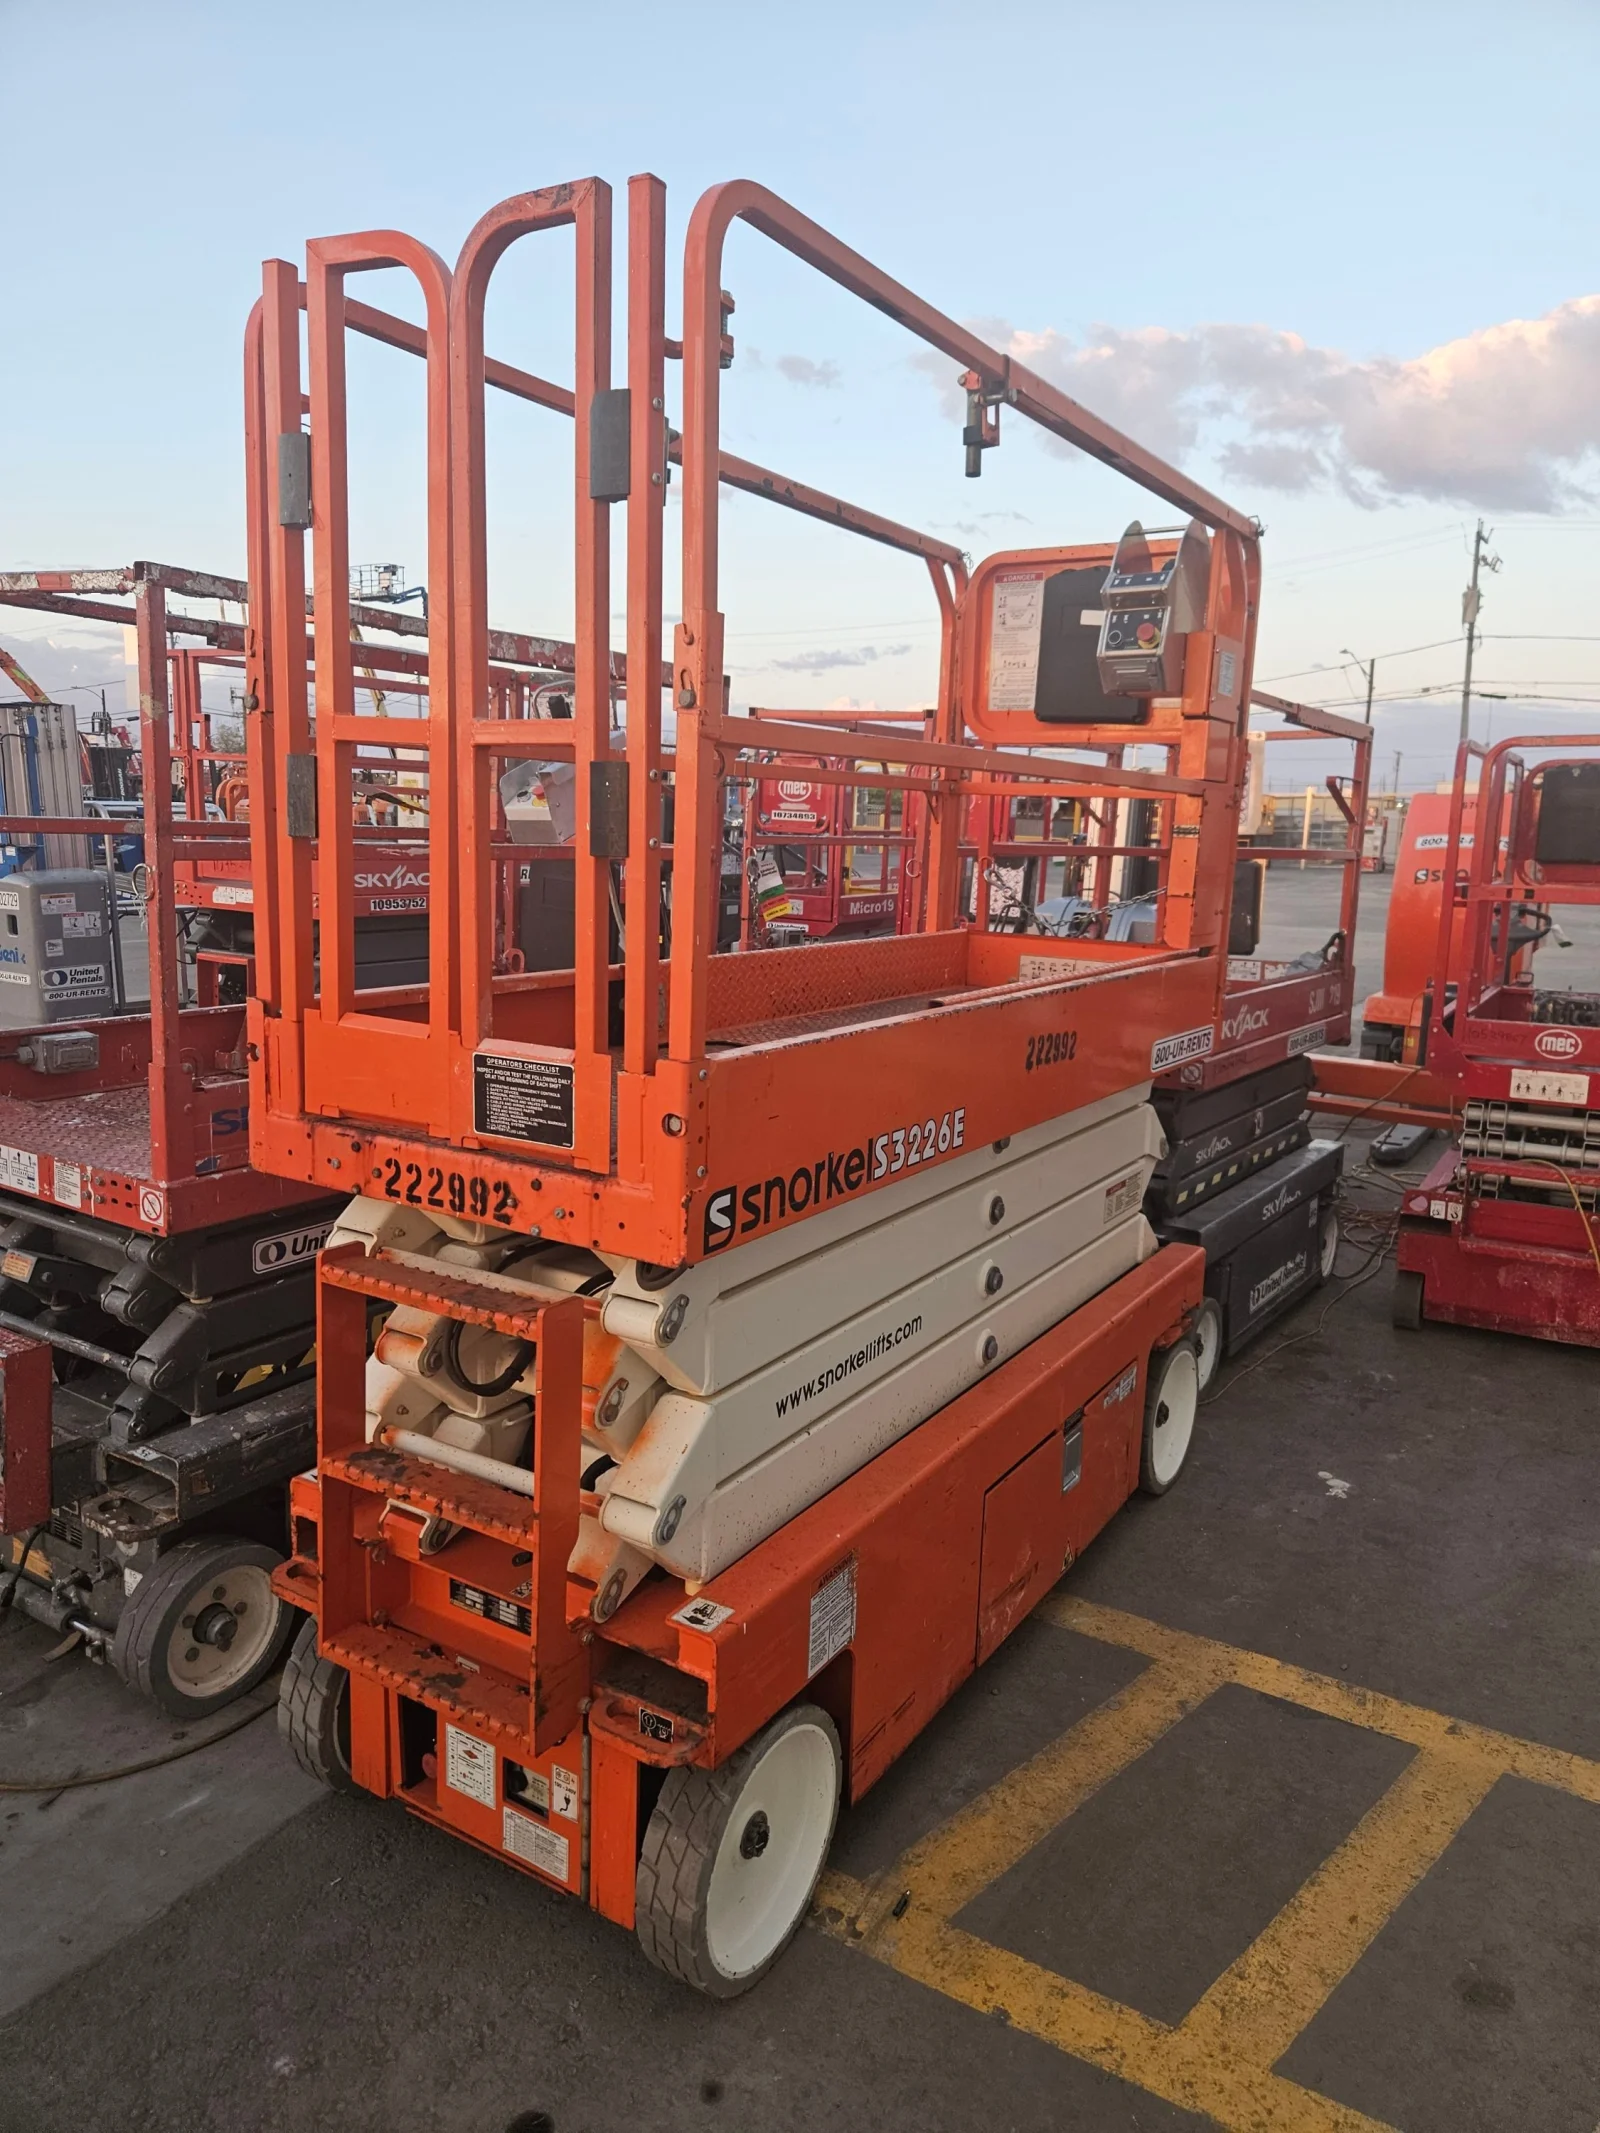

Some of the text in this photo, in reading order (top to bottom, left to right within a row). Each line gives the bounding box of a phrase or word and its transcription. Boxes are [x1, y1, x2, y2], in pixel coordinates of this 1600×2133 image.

[772, 811, 816, 821] 10734893
[353, 865, 430, 889] SKYJAC
[371, 897, 426, 911] 10953752
[850, 899, 895, 915] Micro19
[69, 966, 101, 977] United
[69, 974, 104, 985] Rentals
[48, 988, 107, 1000] 800-UR-RENTS
[1220, 1004, 1270, 1041] KYJACK
[1025, 1030, 1077, 1072] 222992
[1154, 1031, 1212, 1065] 800-UR-RENTS
[1541, 1036, 1576, 1053] mec
[487, 1058, 559, 1073] OPERATORS CHECKLIST
[532, 1073, 557, 1083] FOLLOWING
[558, 1077, 571, 1085] DAILY
[740, 1138, 874, 1235] snorkel
[872, 1107, 966, 1182] S3226E
[384, 1157, 514, 1226] 222992
[291, 1229, 331, 1256] Uni
[775, 1315, 923, 1418] www.snorkellifts.com
